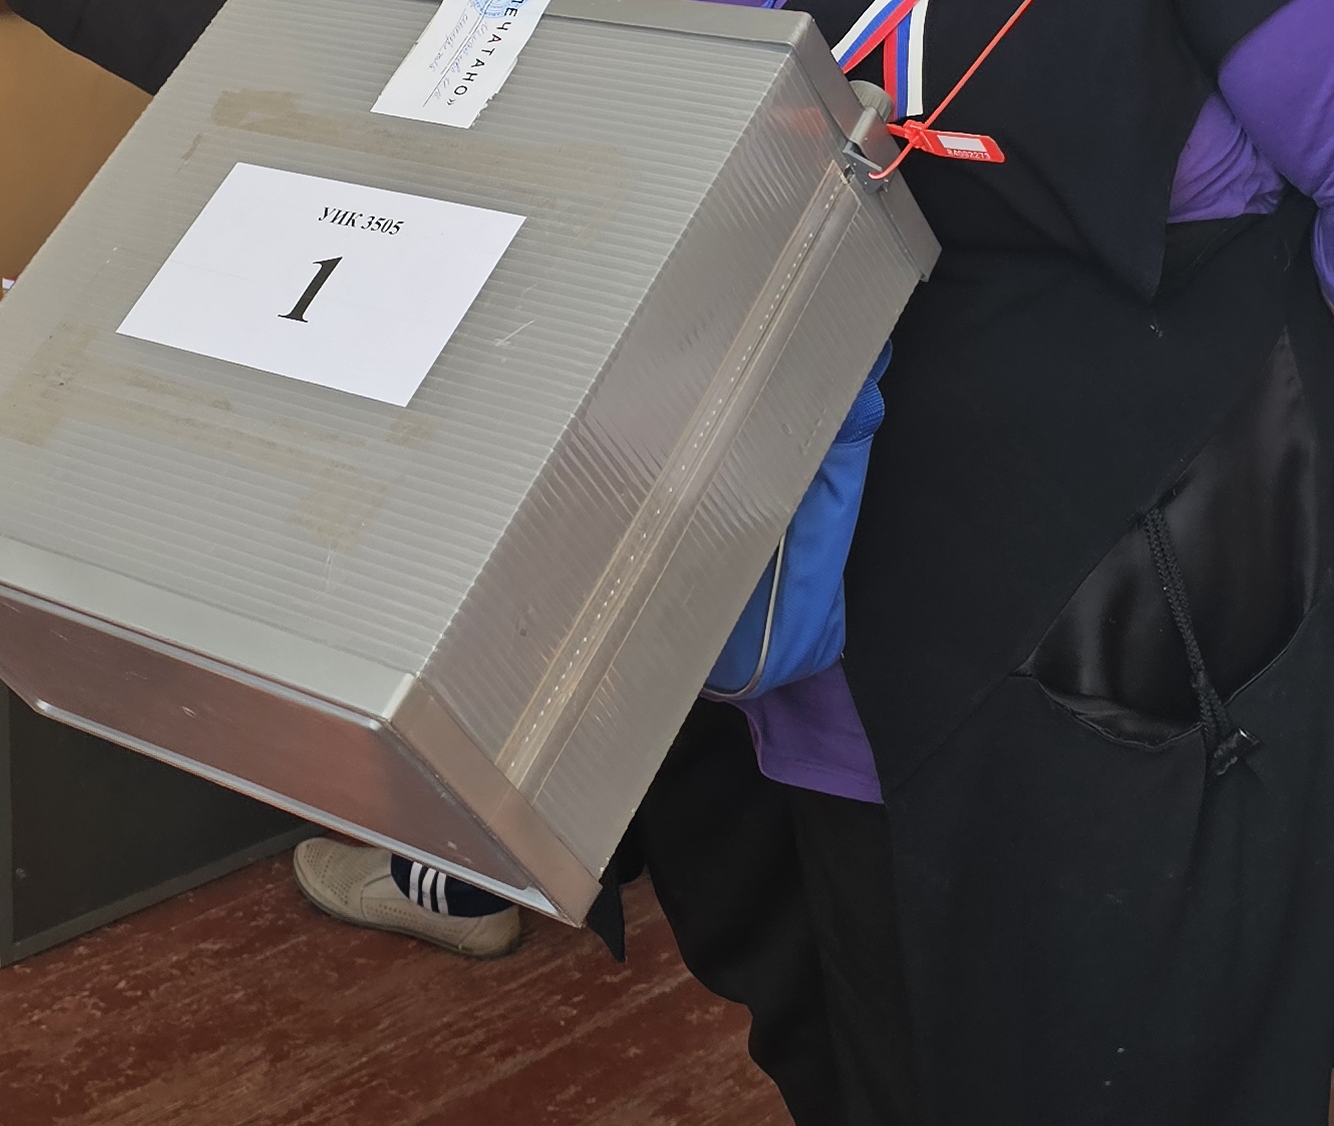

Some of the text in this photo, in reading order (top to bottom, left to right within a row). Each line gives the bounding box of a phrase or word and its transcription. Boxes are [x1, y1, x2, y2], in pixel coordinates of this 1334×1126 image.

[318, 206, 405, 236] УИК 3505
[277, 255, 343, 323] 1
